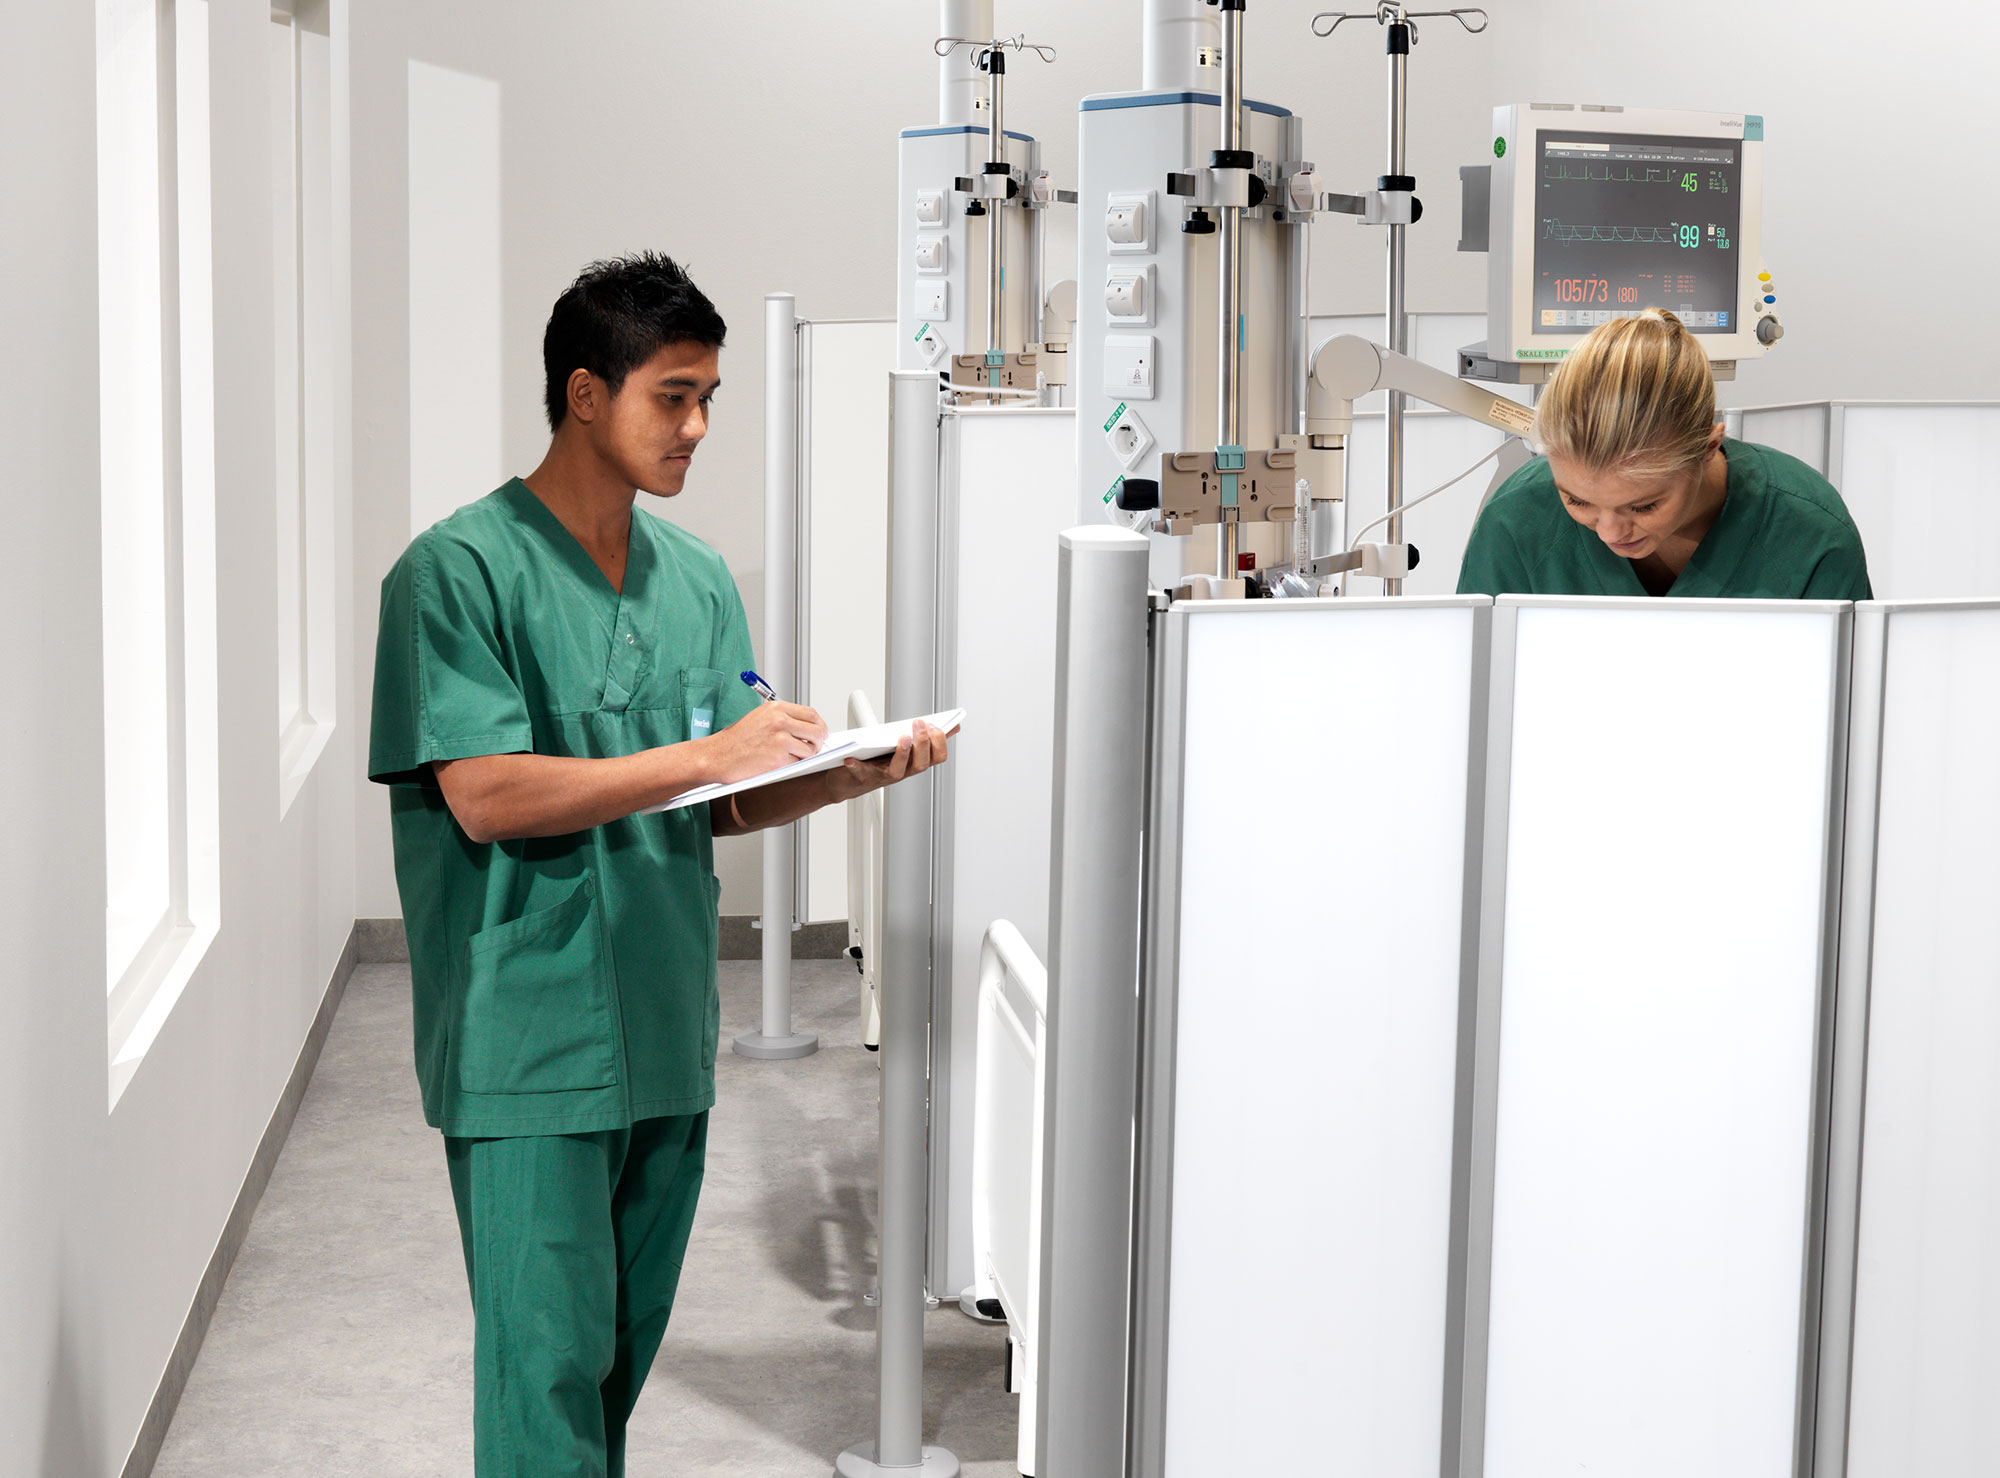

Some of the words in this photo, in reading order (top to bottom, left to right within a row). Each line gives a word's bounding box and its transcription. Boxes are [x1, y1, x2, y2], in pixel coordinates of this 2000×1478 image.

[1680, 172, 1698, 192] 45
[1680, 225, 1700, 248] 99
[1554, 279, 1608, 303] 105/73
[1617, 287, 1638, 303] (80)
[1518, 350, 1544, 358] SKALL
